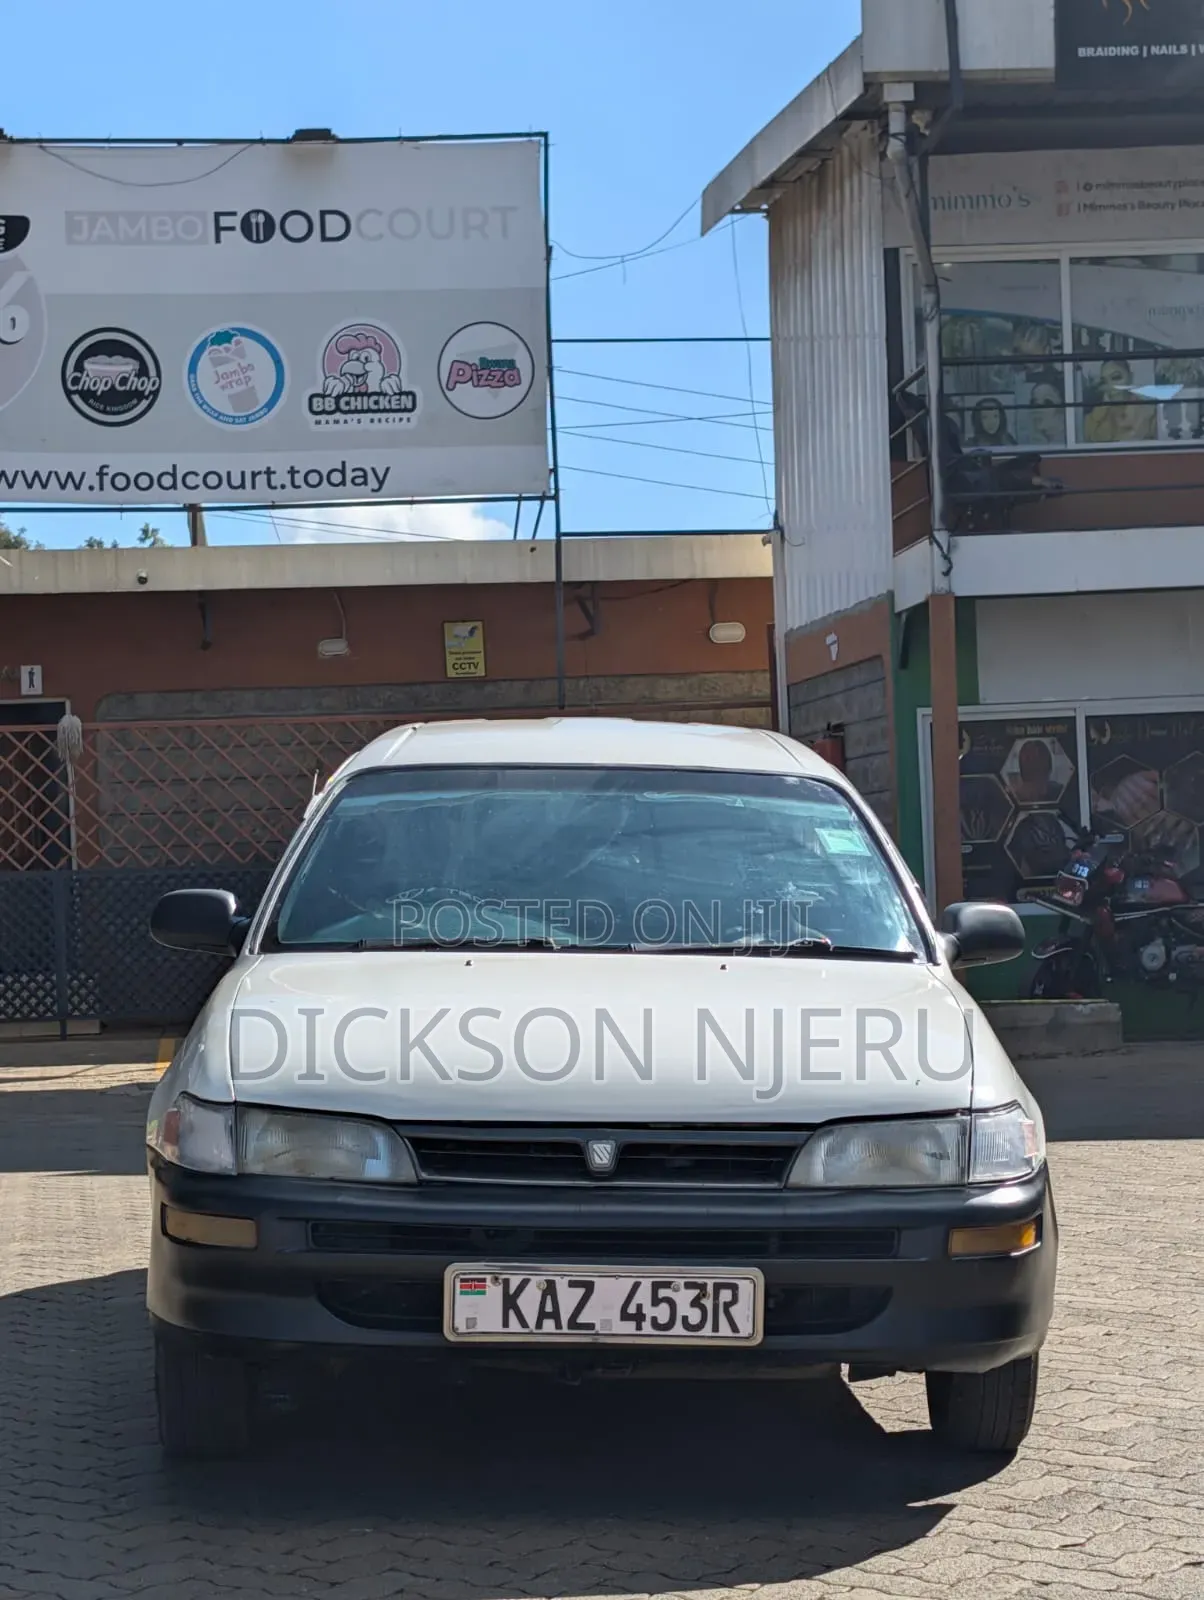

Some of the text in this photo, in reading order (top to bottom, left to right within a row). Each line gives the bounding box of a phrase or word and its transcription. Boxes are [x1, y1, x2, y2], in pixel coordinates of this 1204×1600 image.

[1077, 46, 1140, 57] BRAIDING
[1150, 44, 1188, 55] NAILS
[72, 214, 203, 243] JAMBO
[67, 370, 113, 396] Chop
[115, 370, 160, 396] Chop
[213, 362, 255, 384] Jambo
[446, 360, 522, 391] Pizza
[312, 395, 413, 412] BB CHICKEN
[0, 461, 391, 492] www.foodcourt.today
[452, 661, 480, 671] CCTV
[501, 1277, 741, 1334] KAZ 453R
